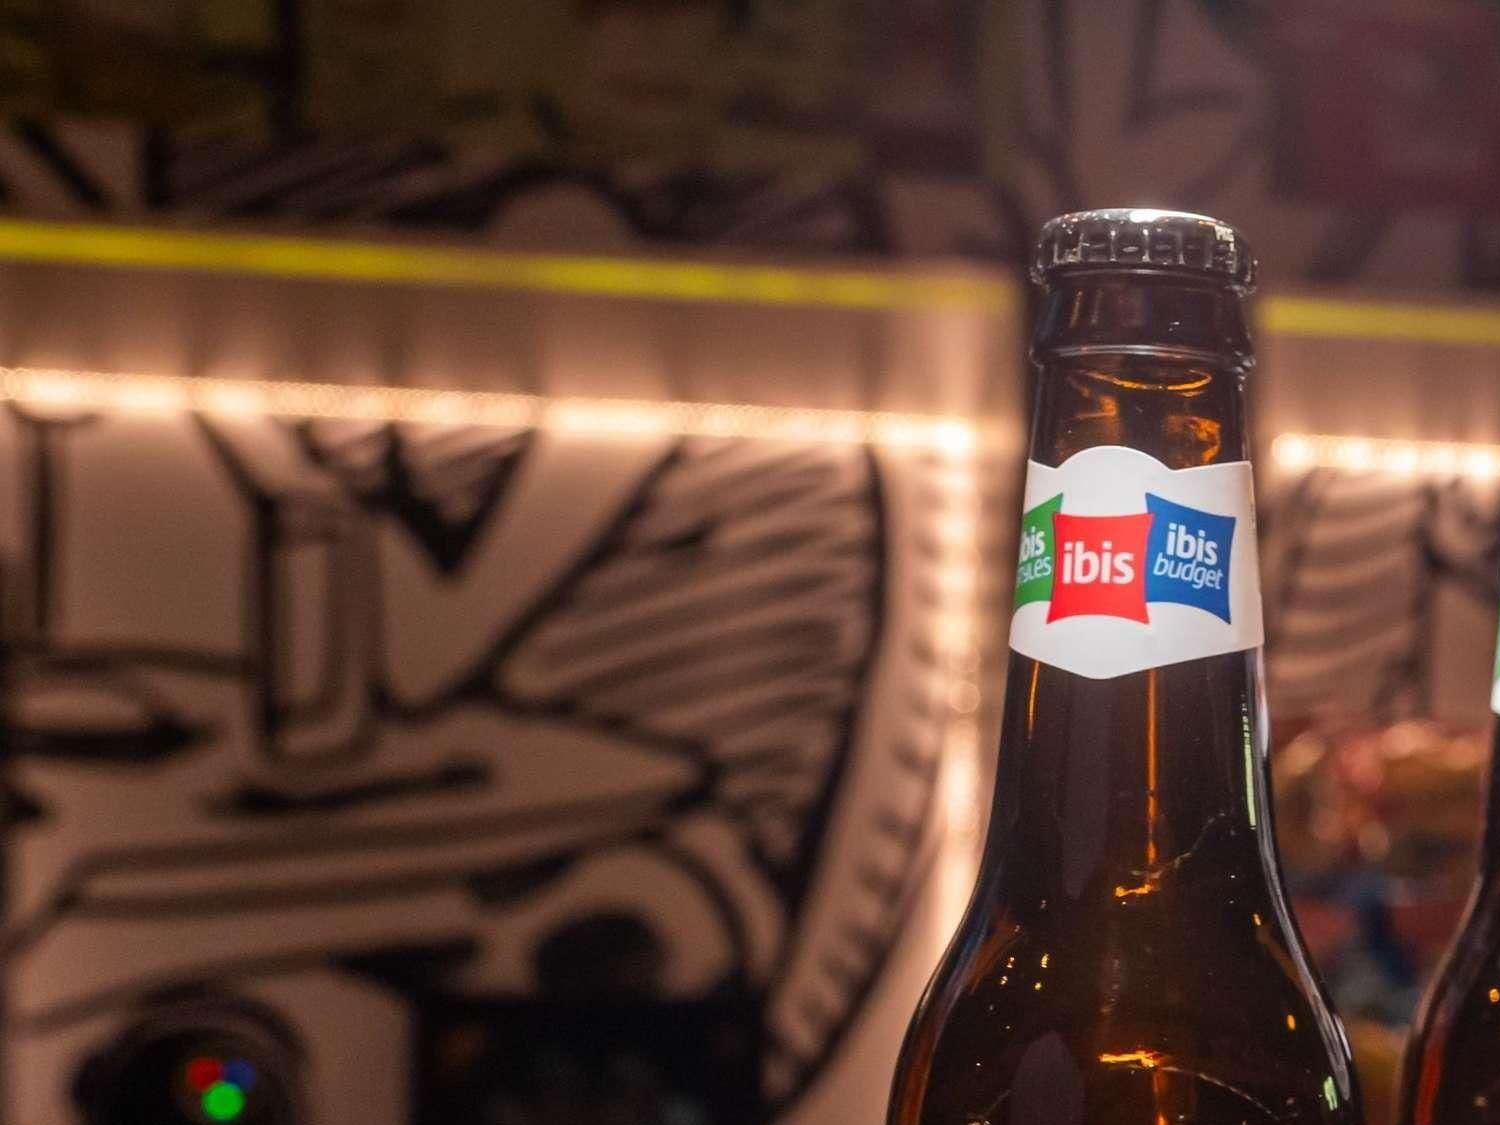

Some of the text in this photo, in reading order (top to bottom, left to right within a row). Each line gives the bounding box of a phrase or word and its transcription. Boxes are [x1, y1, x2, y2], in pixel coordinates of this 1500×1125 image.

[1062, 541, 1135, 585] ibis
[1166, 523, 1218, 566] ibis
[1153, 552, 1224, 590] budget
